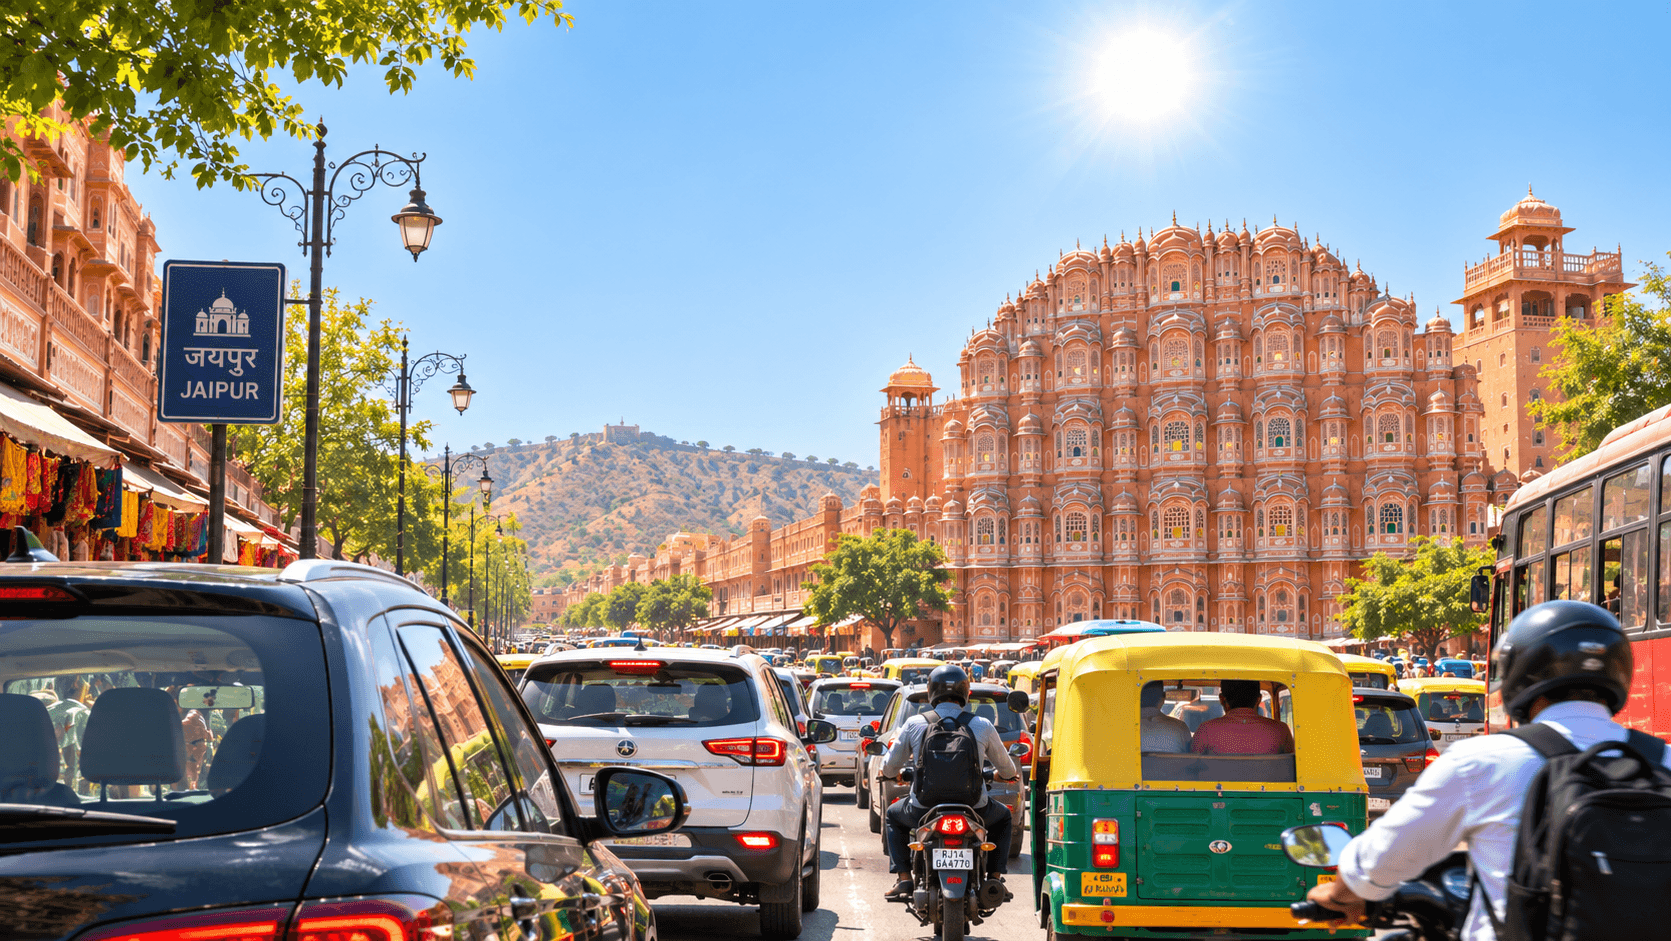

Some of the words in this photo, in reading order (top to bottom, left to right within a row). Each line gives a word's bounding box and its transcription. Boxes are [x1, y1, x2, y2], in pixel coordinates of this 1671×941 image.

[183, 347, 259, 377] जयपुर
[180, 380, 259, 400] JAIPUR
[942, 850, 964, 859] RJ14
